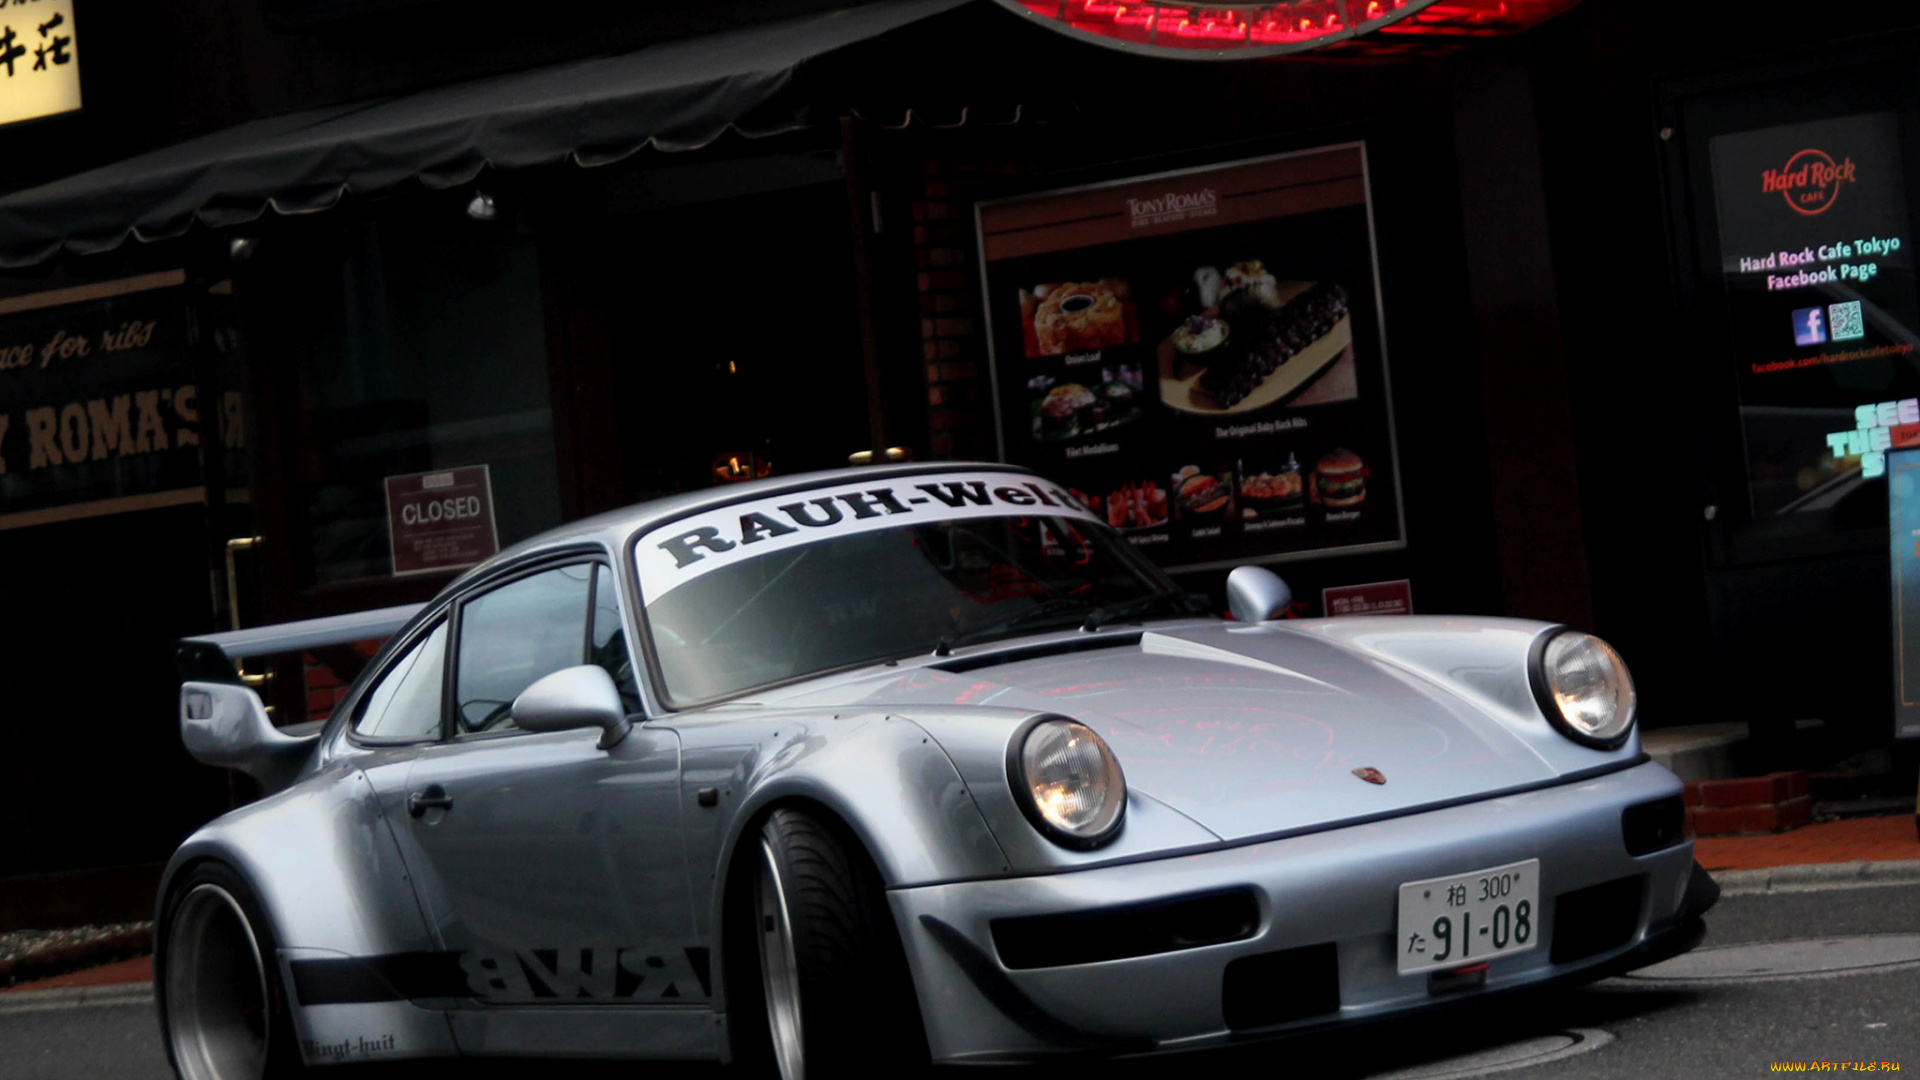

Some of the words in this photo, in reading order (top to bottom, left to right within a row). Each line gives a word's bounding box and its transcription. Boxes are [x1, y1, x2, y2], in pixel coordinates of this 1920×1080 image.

[1762, 163, 1809, 192] Hard
[1810, 156, 1857, 189] Rock
[1740, 252, 1776, 274] Hard
[1778, 246, 1815, 267] Rock
[1818, 241, 1852, 261] Cafe
[1853, 236, 1901, 257] Tokyo
[1767, 265, 1838, 291] Facebook
[1840, 262, 1878, 282] Page
[41, 330, 93, 369] for
[100, 319, 157, 352] ribs
[25, 384, 203, 471] ROMA'S
[1855, 398, 1920, 429] SEE
[1826, 426, 1892, 458] THE
[402, 496, 480, 526] CLOSED
[657, 480, 1083, 569] RAUH-Welt
[1447, 883, 1466, 907] 柏
[1479, 873, 1511, 902] 300
[1408, 932, 1426, 954] た
[1433, 899, 1531, 961] 91-08
